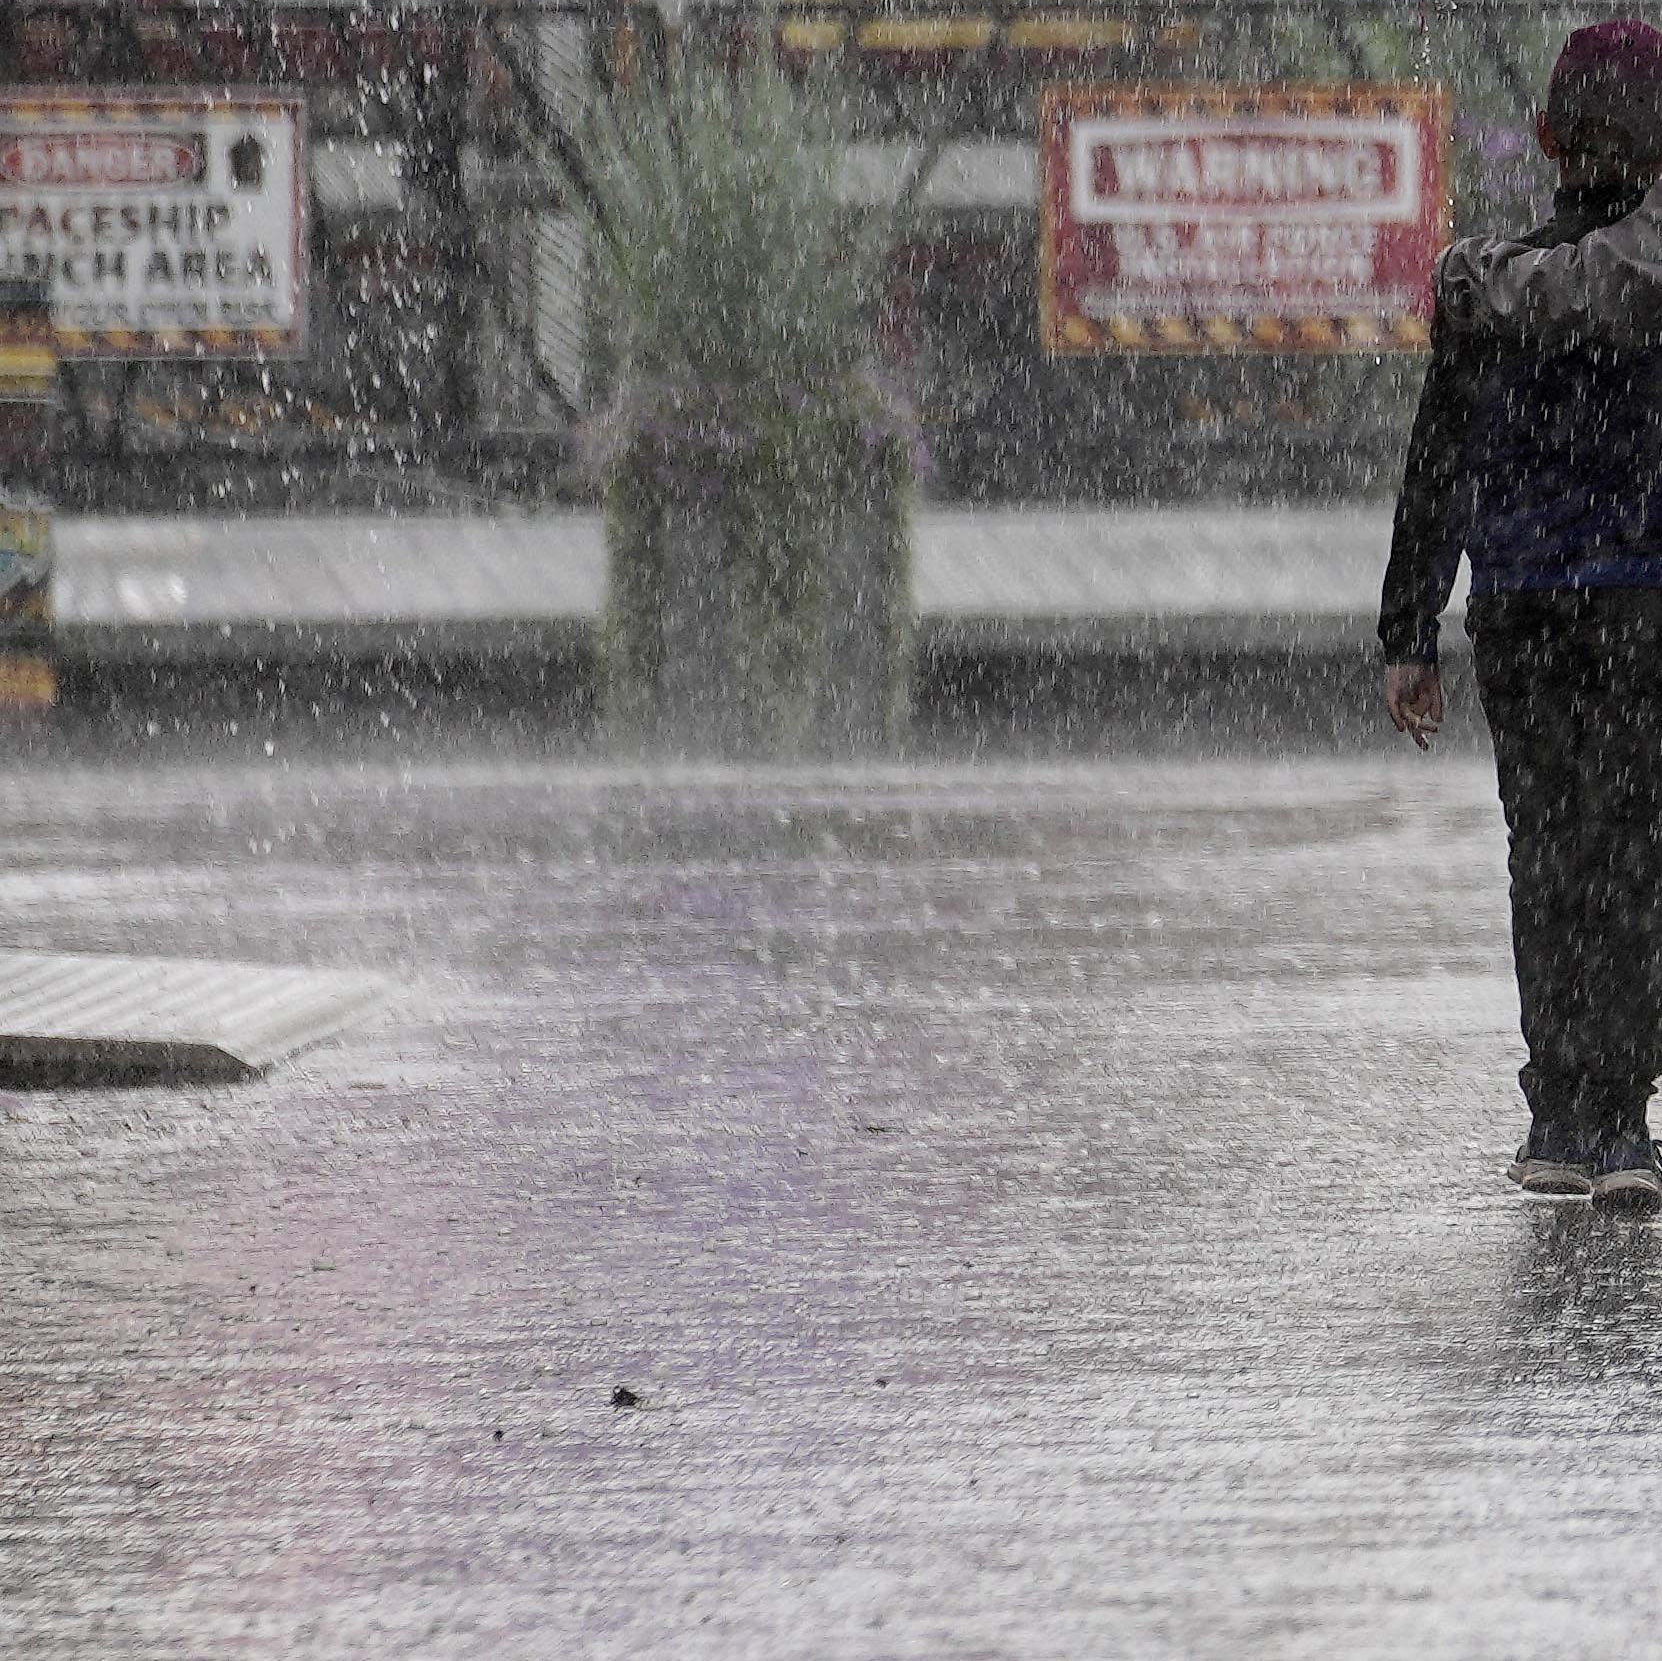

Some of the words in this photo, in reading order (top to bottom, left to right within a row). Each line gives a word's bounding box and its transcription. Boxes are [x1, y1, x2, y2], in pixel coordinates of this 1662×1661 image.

[1114, 143, 1382, 198] WARNING
[0, 203, 232, 241] PACESHIP
[150, 249, 273, 287] AREA
